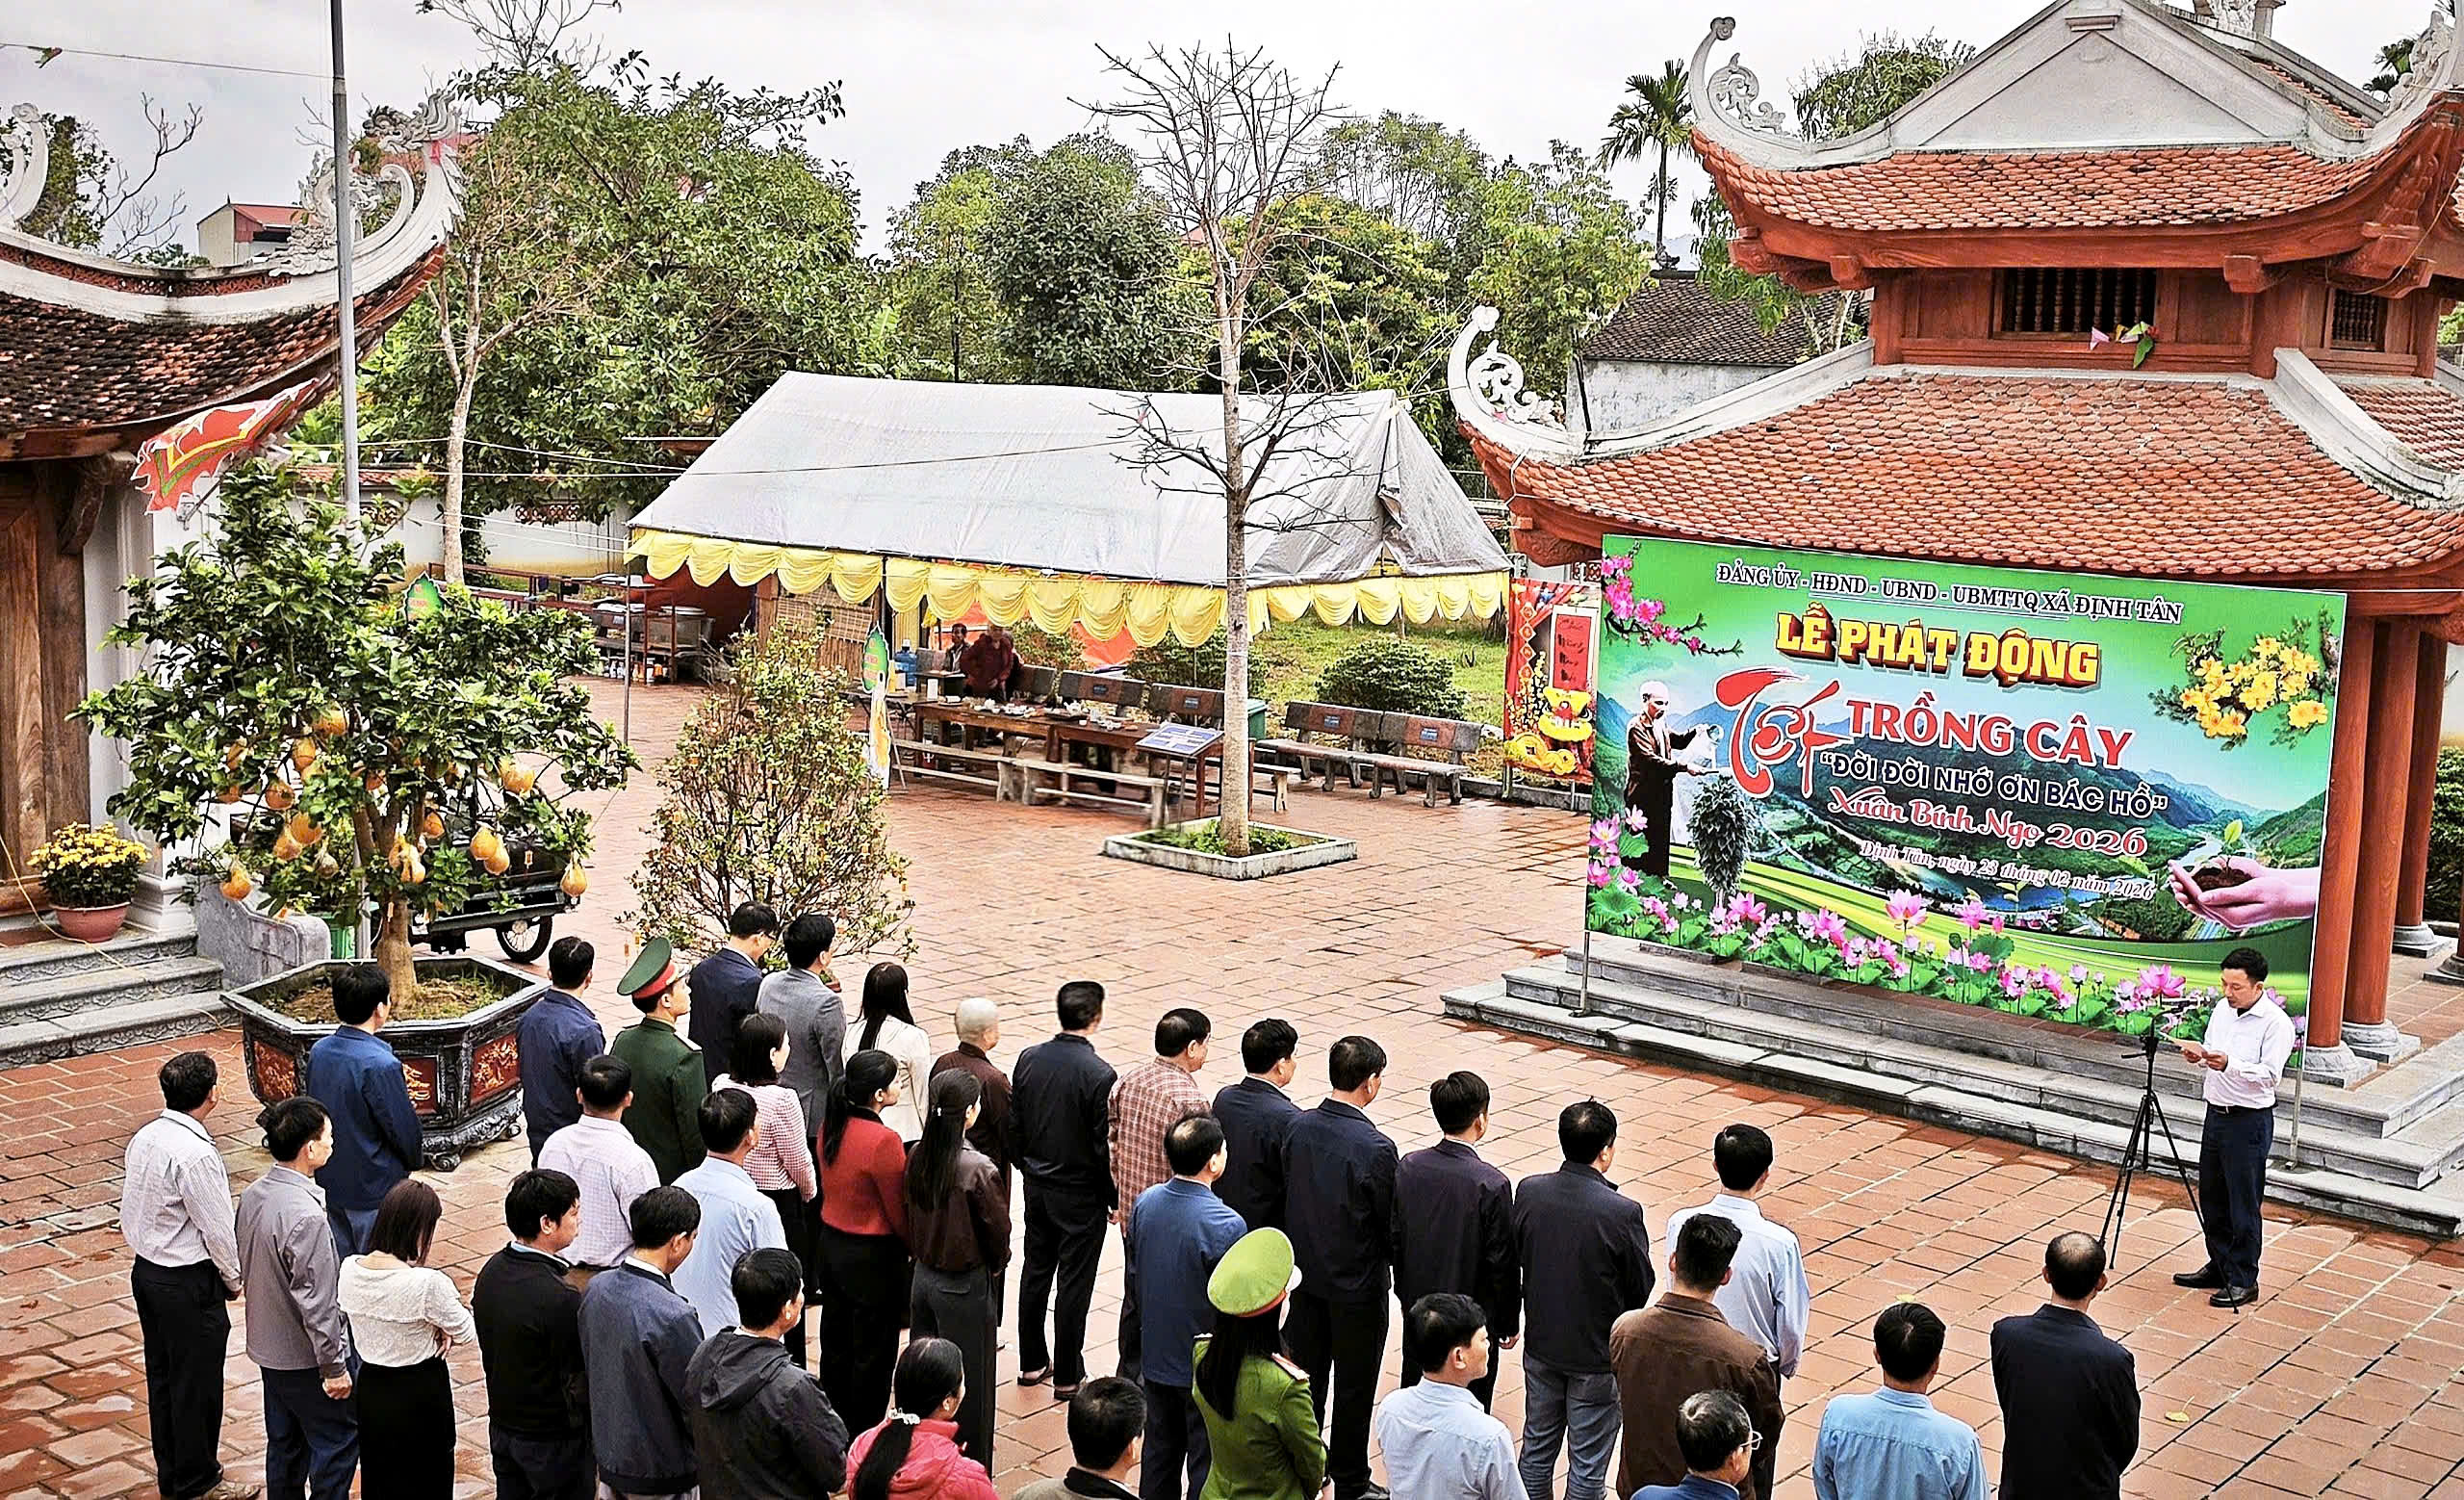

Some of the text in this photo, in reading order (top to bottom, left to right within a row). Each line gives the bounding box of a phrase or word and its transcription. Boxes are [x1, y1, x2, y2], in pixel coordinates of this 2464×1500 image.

[1718, 560, 1769, 584] ĐẢNG
[1773, 563, 1800, 588] ỦY
[1812, 575, 1867, 594] HĐND
[1883, 581, 1938, 601] UBND
[1953, 585, 2040, 611] UBMTTQ
[2040, 589, 2069, 613] XÃ
[2074, 596, 2132, 621] ĐỊNH
[2137, 598, 2183, 623] TÂN
[1776, 601, 2102, 689] LỄ PHÁT ĐỘNG
[1846, 690, 2014, 754] TRỒNG
[2025, 714, 2134, 767] CÂY
[1884, 756, 1929, 787] ĐỜI
[1936, 768, 1992, 795] NHỚ
[1998, 774, 2039, 803] ƠN
[2046, 781, 2103, 811] BÁC
[1829, 786, 2147, 856] Xuân Bính Ngọ 2026
[1861, 841, 2154, 900] Định Tân, ngày 23 tháng 02 năm 2026
